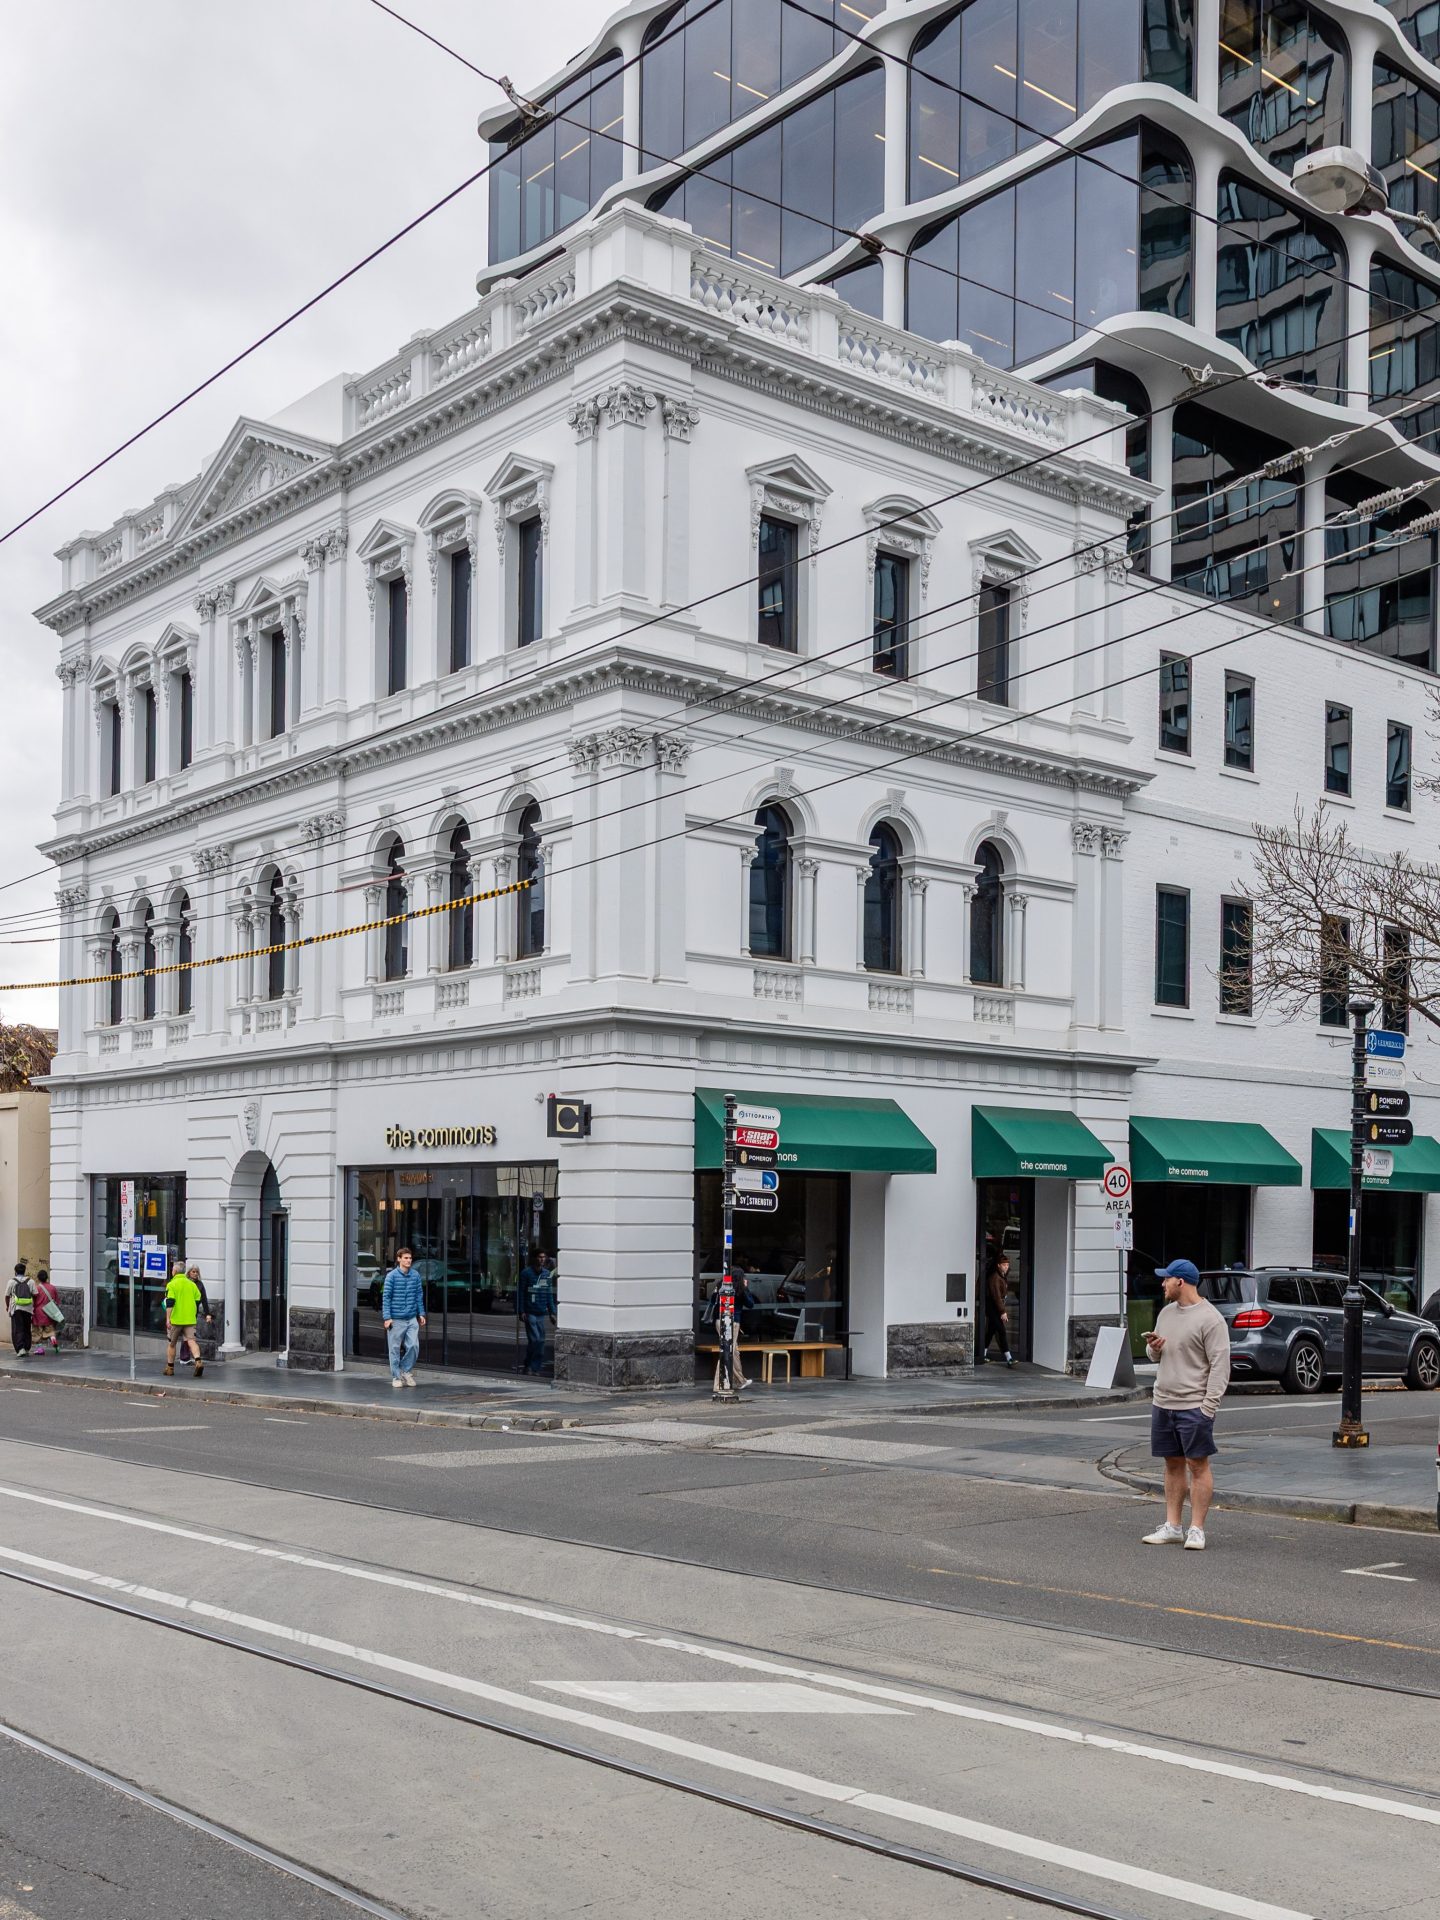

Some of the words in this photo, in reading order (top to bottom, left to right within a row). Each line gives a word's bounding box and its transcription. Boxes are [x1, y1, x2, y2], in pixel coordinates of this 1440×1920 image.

[1379, 1097, 1404, 1106] POMEROY
[557, 1104, 579, 1133] C
[386, 1124, 412, 1148] the
[416, 1126, 495, 1147] commons
[748, 1155, 773, 1163] POMEROY
[1020, 1160, 1034, 1170] the
[1034, 1163, 1068, 1171] commons
[1168, 1166, 1180, 1175] the
[1180, 1168, 1209, 1177] commons
[1109, 1174, 1127, 1188] 40
[1105, 1200, 1131, 1211] AREA
